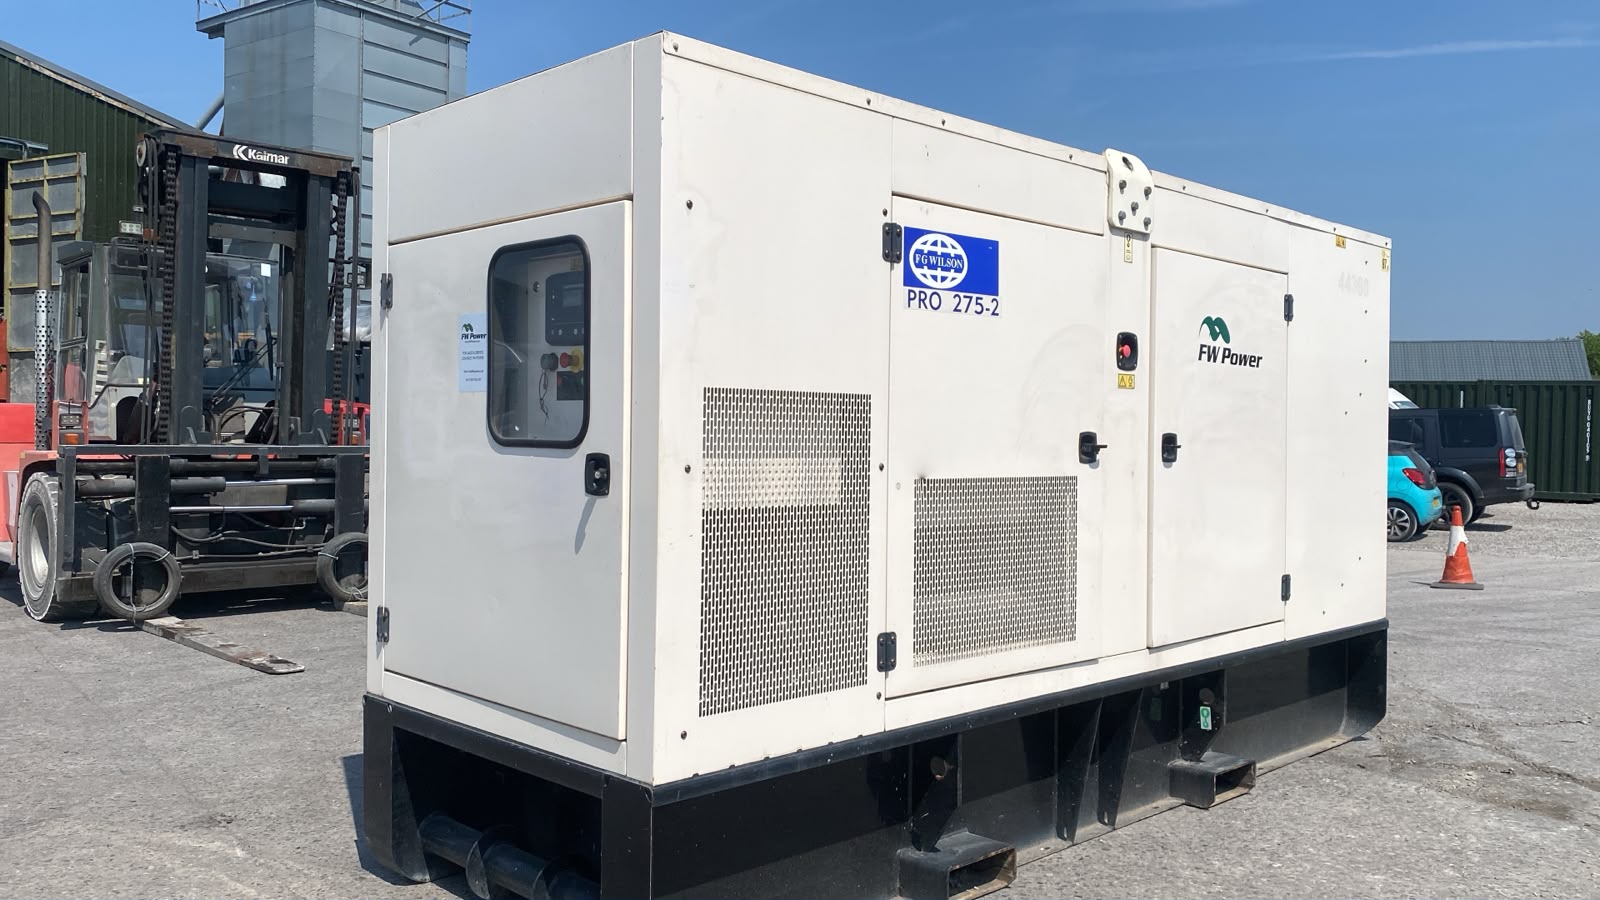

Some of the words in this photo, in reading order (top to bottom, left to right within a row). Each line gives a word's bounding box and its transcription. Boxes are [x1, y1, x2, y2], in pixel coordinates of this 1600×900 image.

[907, 289, 942, 311] PRO
[952, 293, 1000, 316] 275-2
[1198, 343, 1221, 364] FW
[1221, 347, 1263, 369] Power
